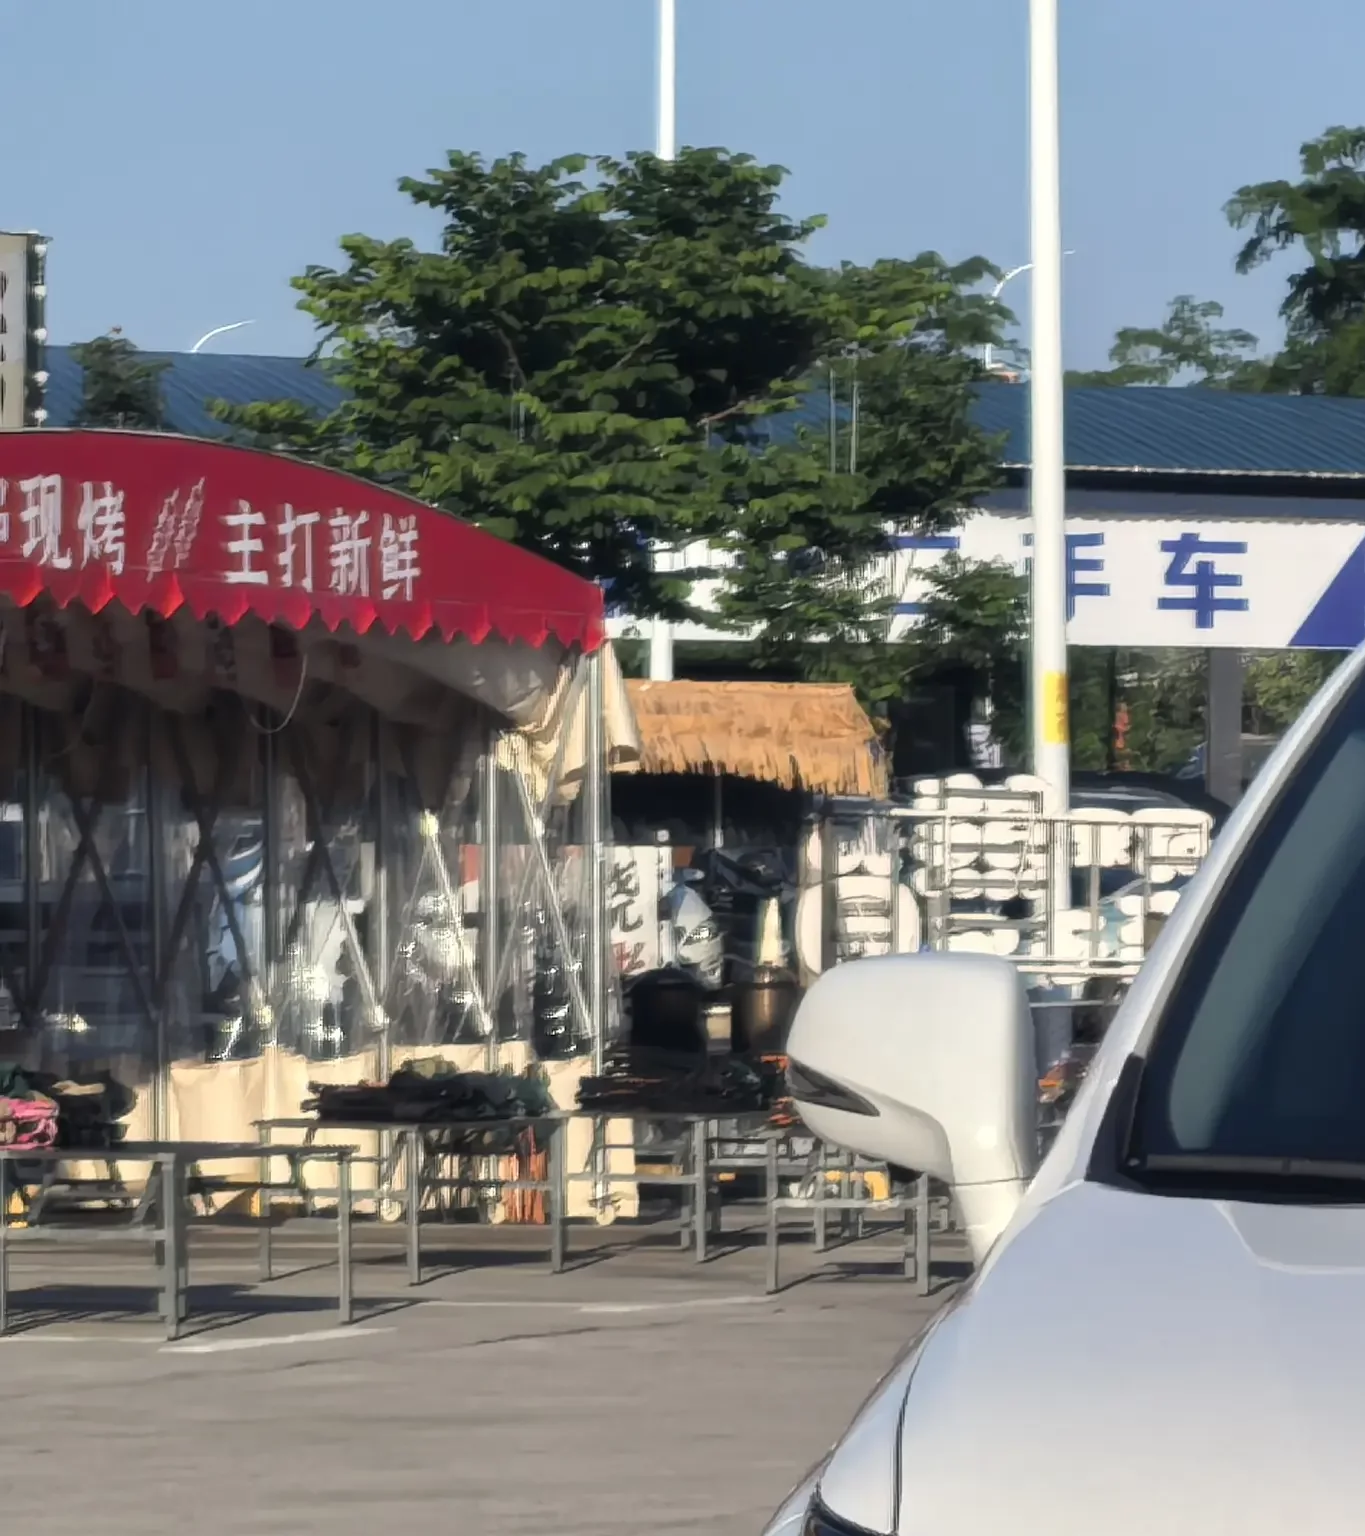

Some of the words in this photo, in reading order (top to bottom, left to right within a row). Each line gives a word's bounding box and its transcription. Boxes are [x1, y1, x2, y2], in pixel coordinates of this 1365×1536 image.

[0, 473, 125, 575] 现烤
[222, 499, 421, 601] 主打新鲜
